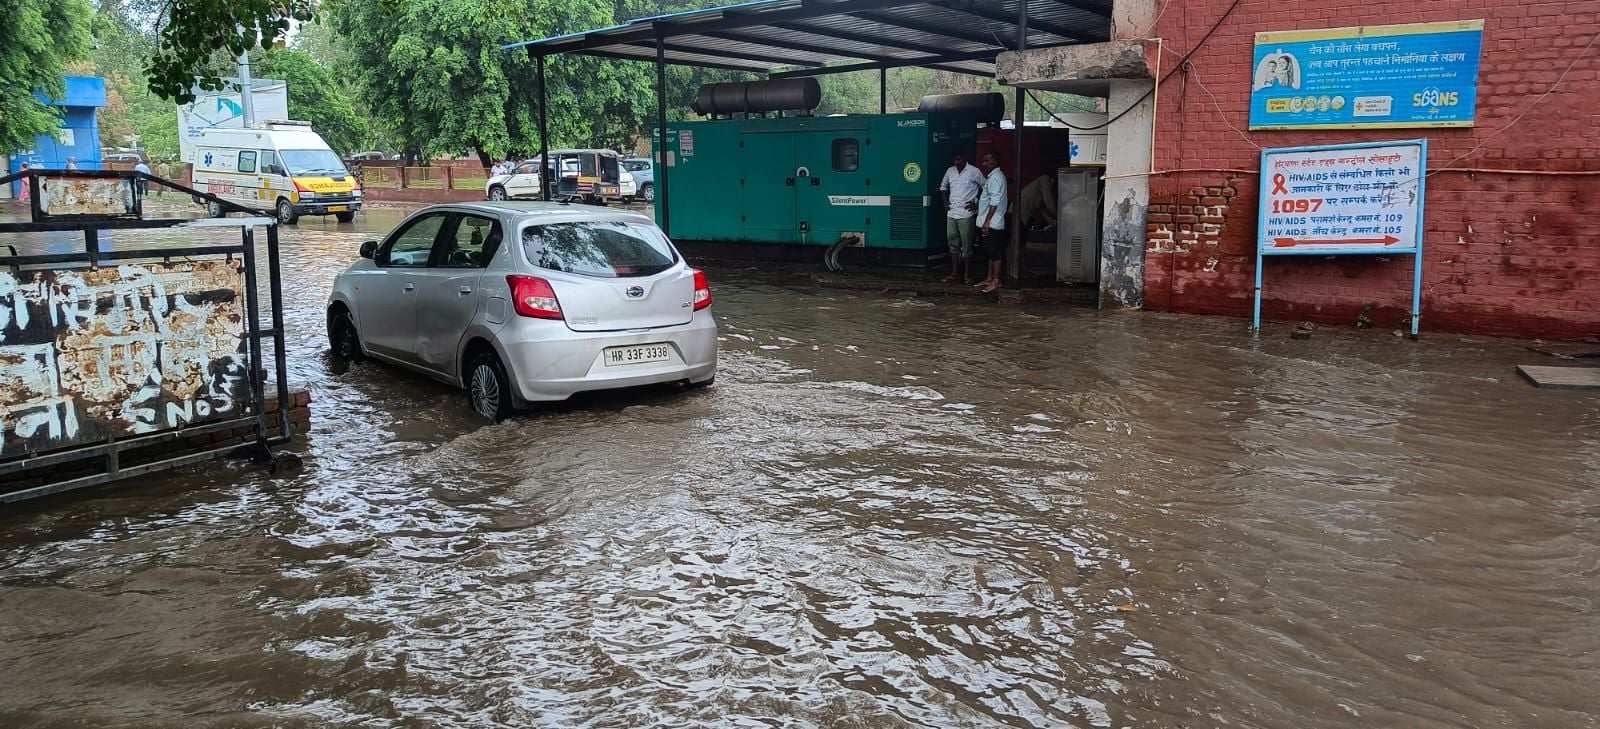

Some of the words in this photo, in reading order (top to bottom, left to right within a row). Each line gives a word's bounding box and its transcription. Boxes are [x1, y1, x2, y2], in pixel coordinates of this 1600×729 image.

[1324, 42, 1335, 54] की
[1324, 59, 1338, 68] आप
[1429, 51, 1440, 63] के
[1440, 53, 1466, 63] लक्षण
[1289, 172, 1328, 182] HIV/AIDS
[1330, 170, 1337, 180] से
[1398, 166, 1411, 176] भी
[1290, 183, 1323, 193] जानकारी
[1326, 184, 1333, 192] के
[1334, 183, 1351, 192] लिए
[1272, 198, 1324, 214] 1097
[1325, 198, 1338, 206] पर
[1269, 217, 1306, 226] HIV/AIDS
[1385, 214, 1403, 222] 109
[1268, 228, 1307, 236] HIV/AIDS
[1384, 226, 1402, 234] 105
[611, 350, 624, 362] HR
[627, 348, 644, 361] 33F
[646, 346, 668, 359] 3338
